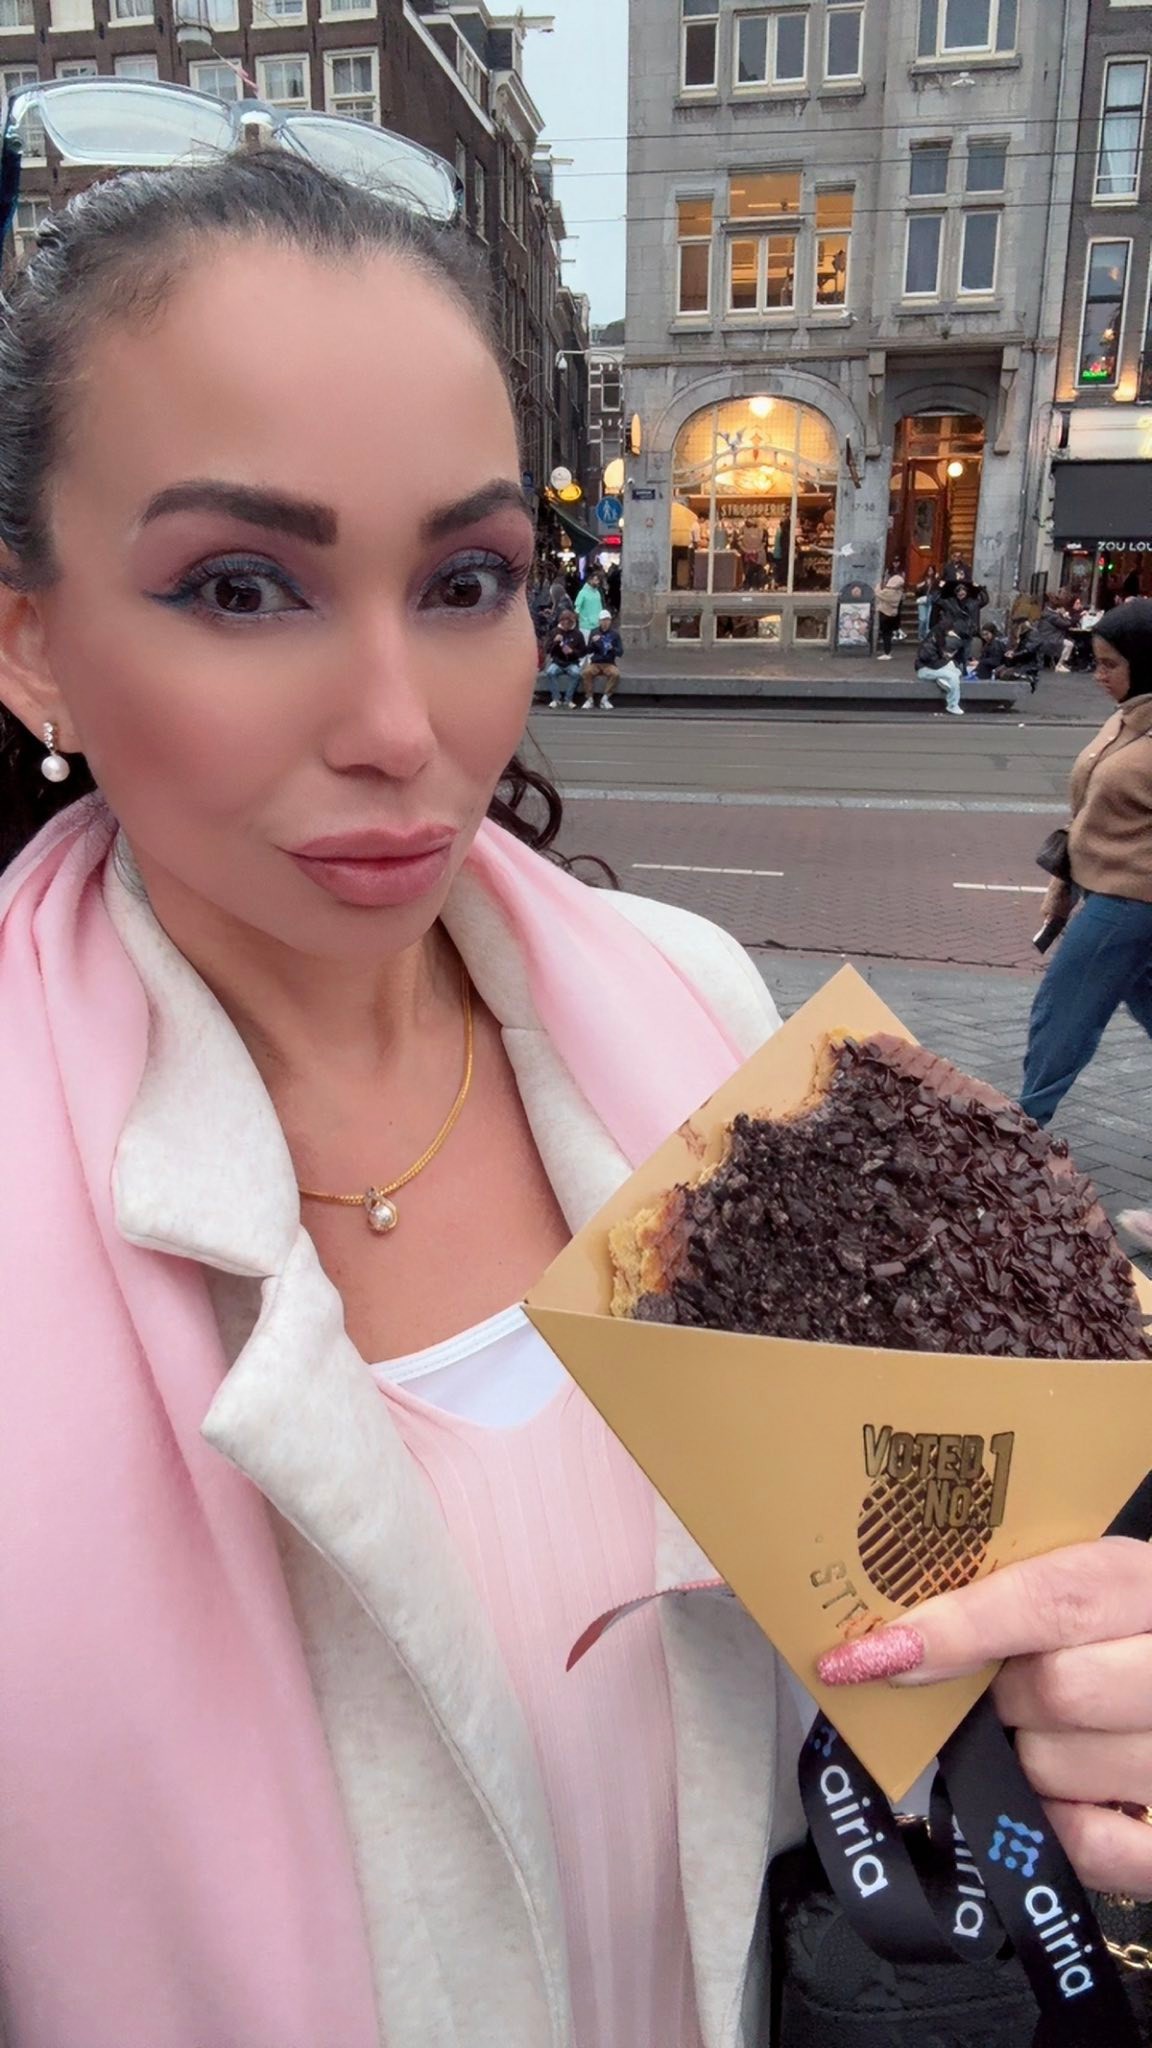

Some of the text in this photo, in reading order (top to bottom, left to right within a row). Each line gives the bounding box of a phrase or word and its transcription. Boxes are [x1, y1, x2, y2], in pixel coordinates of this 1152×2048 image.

[1097, 541, 1126, 551] ZOU
[863, 1423, 985, 1480] VOTED
[819, 1763, 890, 1899] airia
[1024, 1884, 1096, 1999] airia
